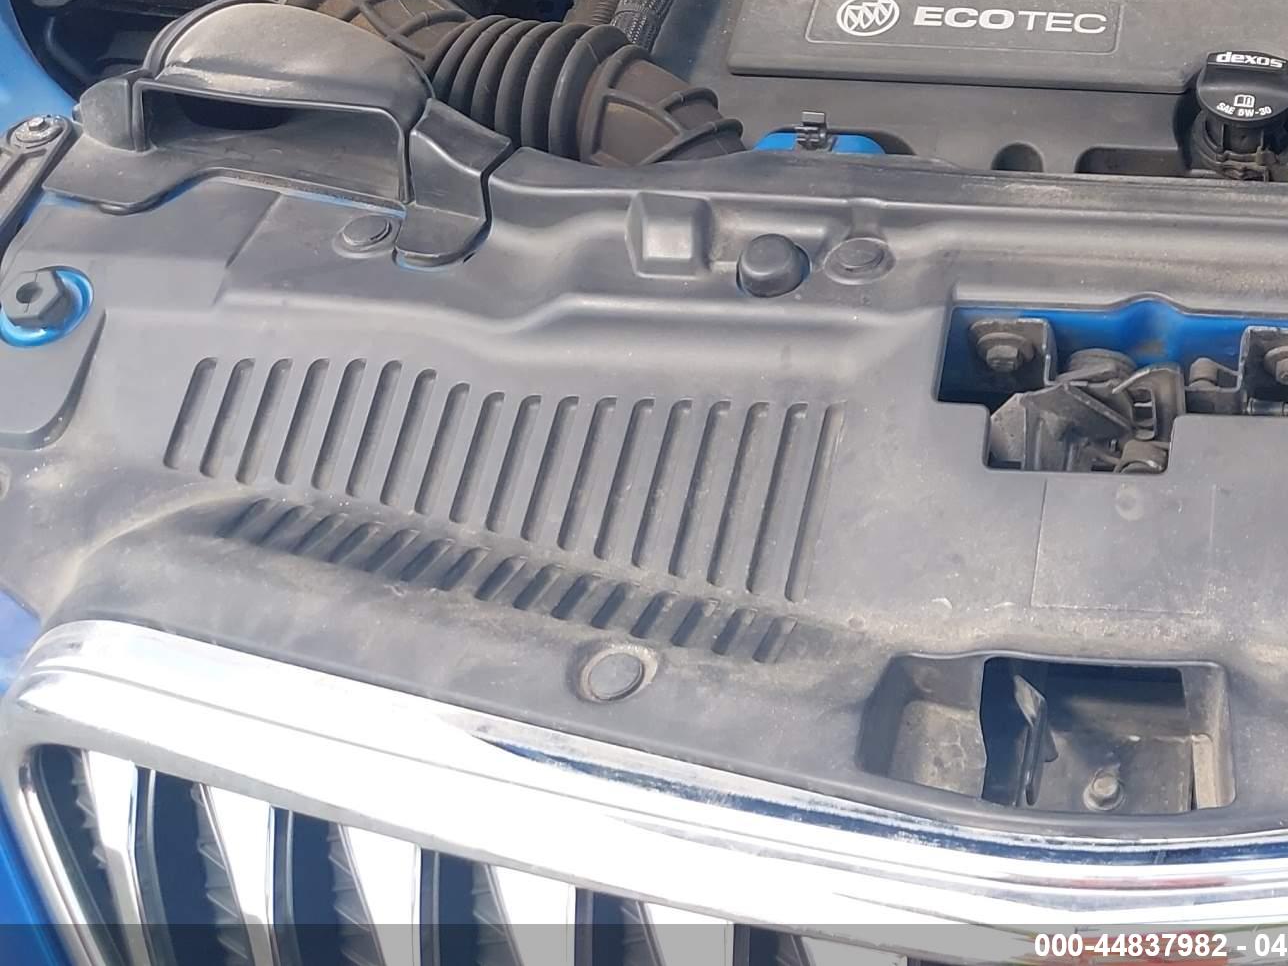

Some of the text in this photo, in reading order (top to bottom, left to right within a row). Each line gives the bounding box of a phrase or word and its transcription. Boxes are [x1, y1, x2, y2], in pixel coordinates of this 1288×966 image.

[913, 5, 1108, 34] ECOTEC
[1216, 51, 1287, 69] dexos
[1216, 102, 1273, 117] SAE 5W-30
